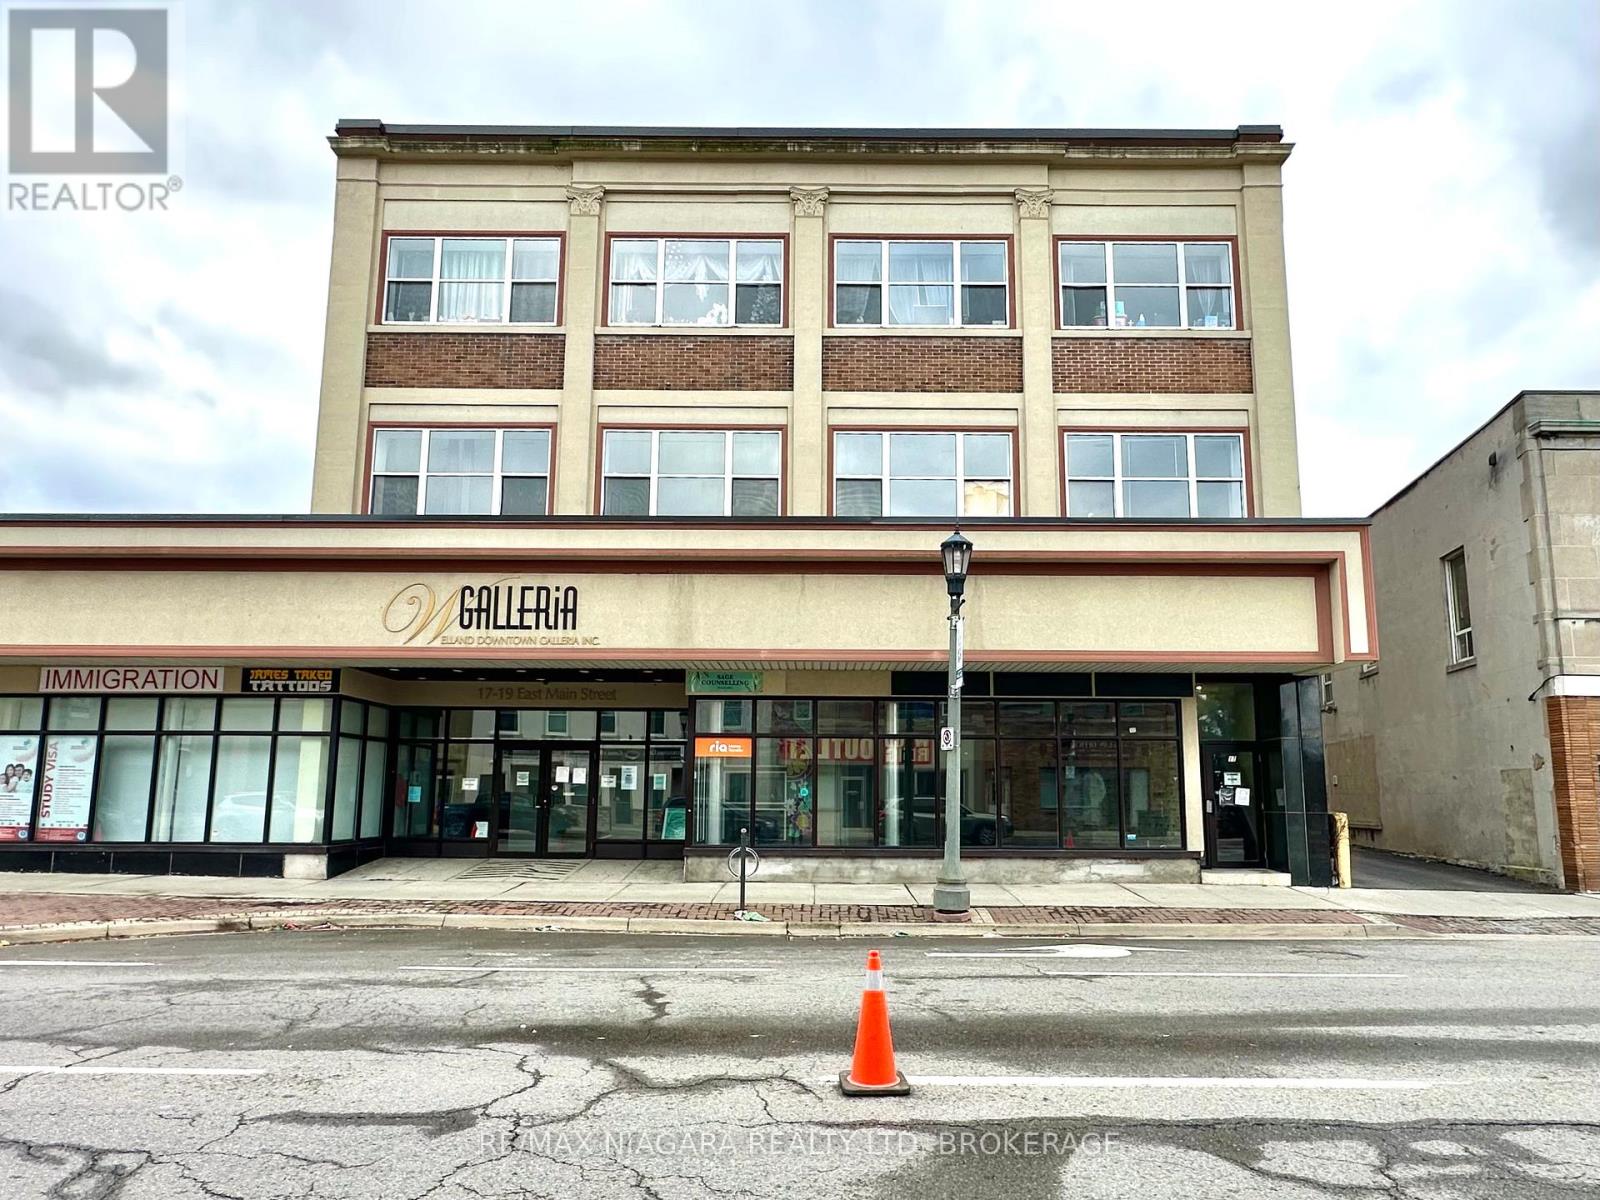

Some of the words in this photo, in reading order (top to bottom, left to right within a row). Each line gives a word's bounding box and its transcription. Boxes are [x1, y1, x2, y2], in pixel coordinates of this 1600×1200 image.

[477, 636, 538, 646] DOWNTOWN
[539, 636, 579, 646] GALLERIA
[45, 669, 219, 690] IMMIGRATION
[250, 669, 289, 680] JAMES
[249, 680, 332, 692] TATTOOS
[478, 687, 514, 700] 17-19
[517, 687, 542, 700] East
[545, 687, 577, 700] Main
[581, 687, 617, 701] Street
[709, 740, 728, 753] ria
[47, 741, 59, 772] VISA
[41, 776, 54, 818] STUDY
